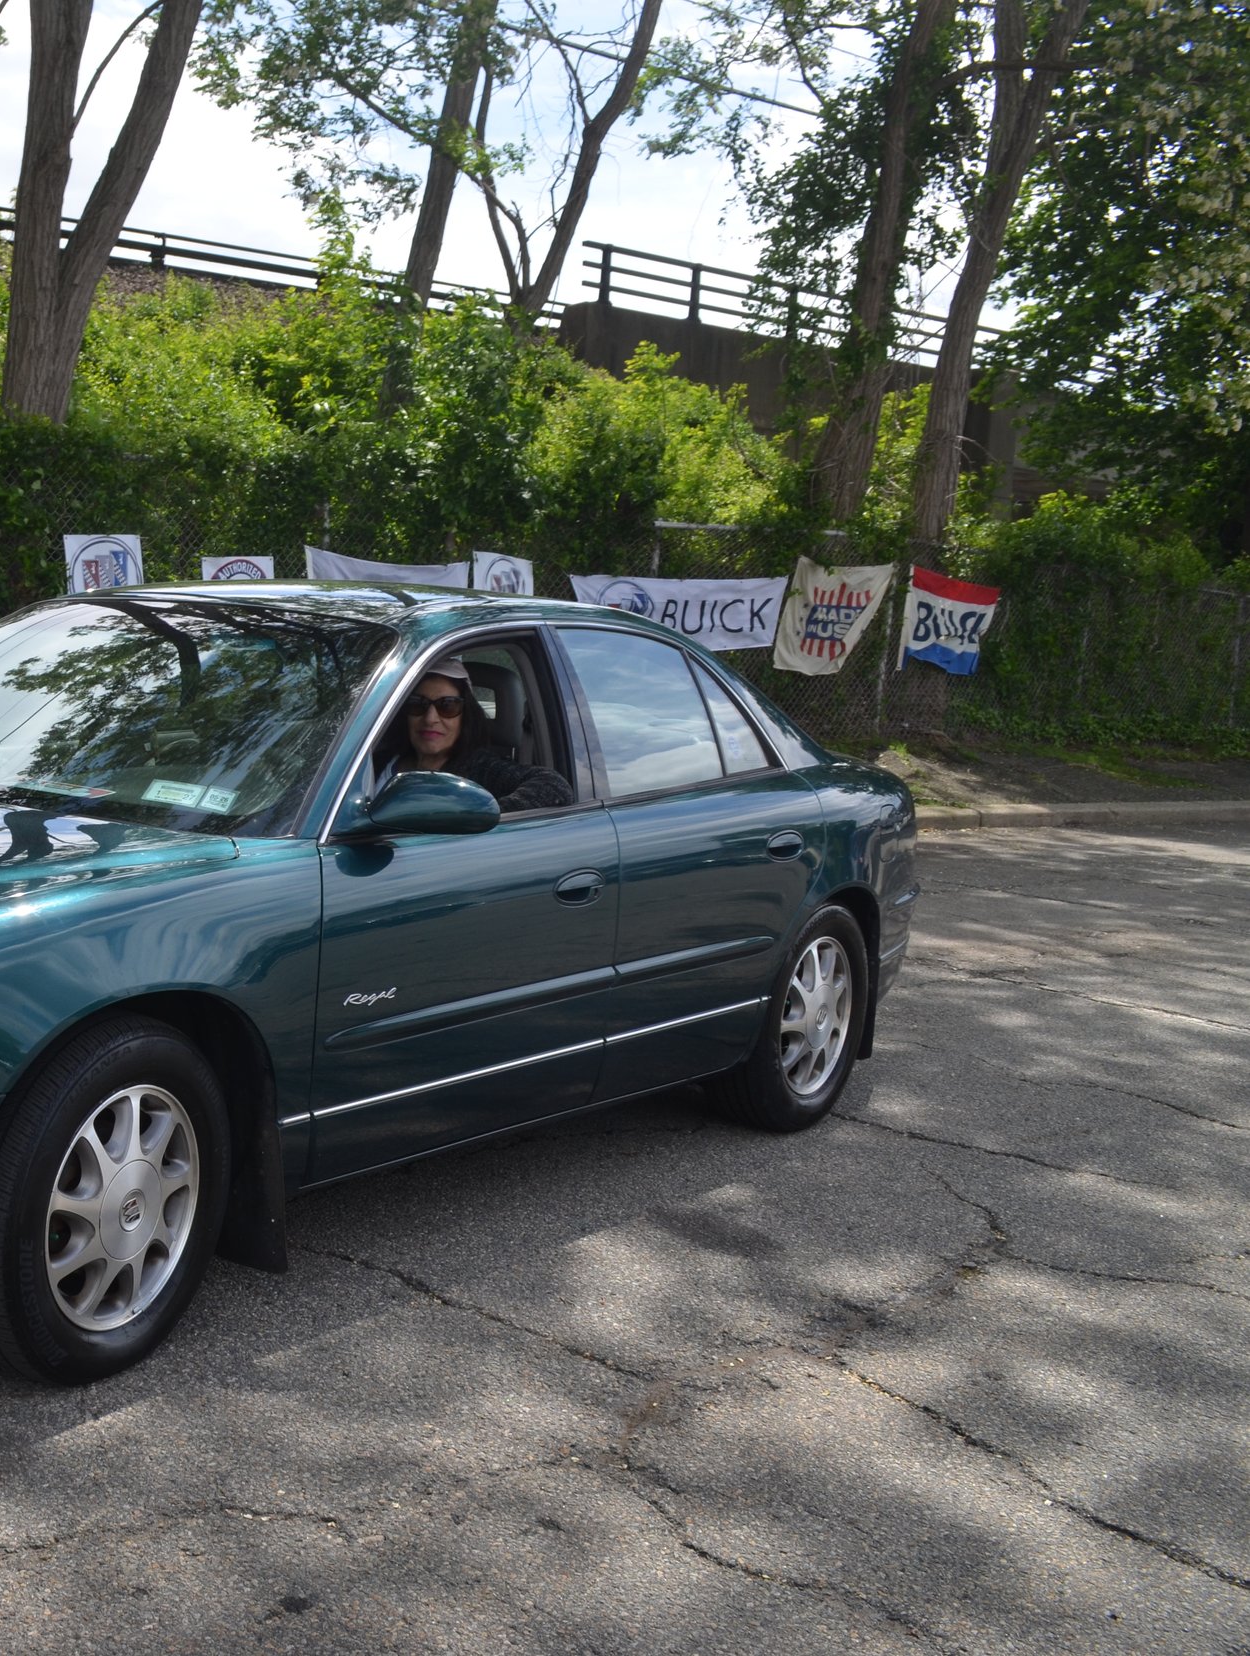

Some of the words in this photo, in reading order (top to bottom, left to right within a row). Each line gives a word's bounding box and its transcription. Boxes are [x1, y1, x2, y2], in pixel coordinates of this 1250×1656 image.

[217, 561, 262, 580] AUTHORIZED
[660, 597, 774, 635] BUICK
[343, 987, 397, 1006] Regal
